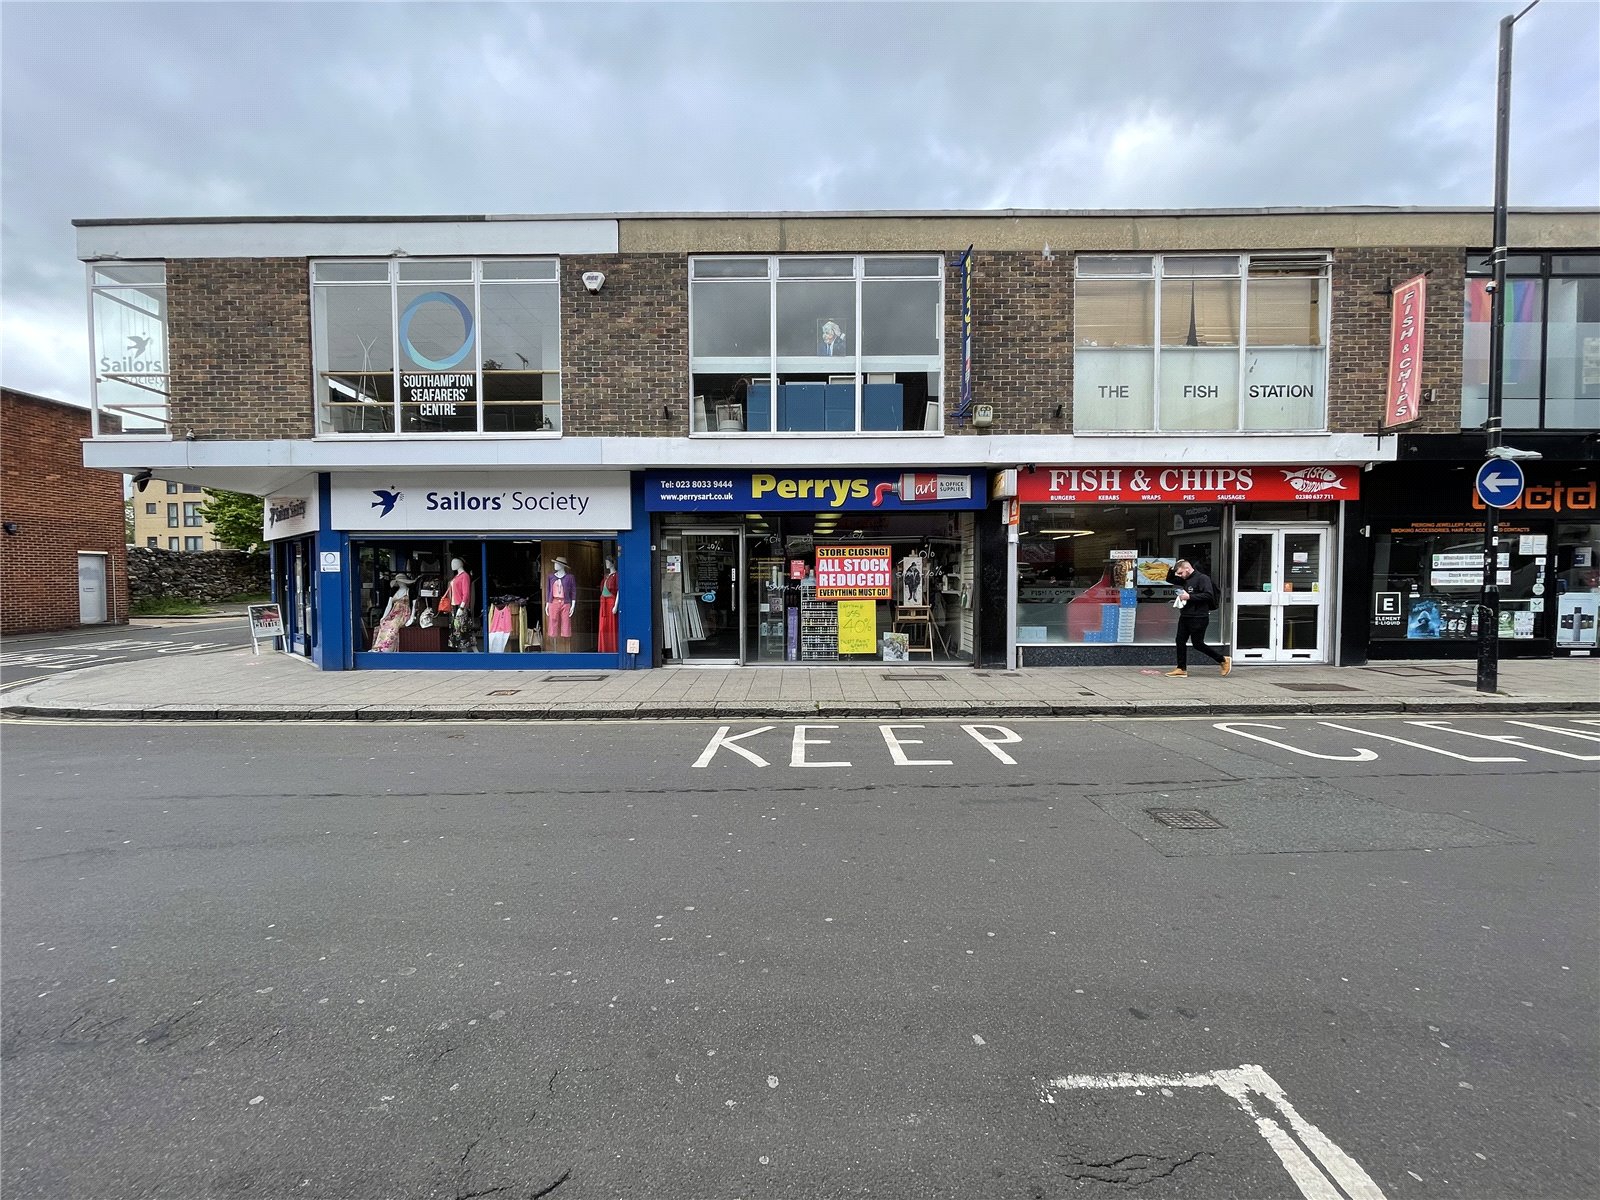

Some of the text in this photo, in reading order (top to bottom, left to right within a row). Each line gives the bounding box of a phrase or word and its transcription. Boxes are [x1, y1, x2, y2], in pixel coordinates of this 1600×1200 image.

[1395, 290, 1414, 417] FISH & CHIPS
[403, 374, 473, 388] SOUTHAMPTON
[1098, 384, 1314, 398] THE FISH STATION
[420, 403, 457, 416] CENTRE
[1048, 468, 1254, 492] FISH & CHIPS
[1303, 467, 1328, 479] FISH
[660, 480, 733, 489] Tel: 023 8033 9444
[751, 474, 869, 507] Perrys
[915, 478, 938, 496] art
[512, 491, 590, 516] Society
[660, 492, 734, 502] www.perrysart.co.uk
[819, 548, 889, 557] STORE CLOSING!
[818, 559, 841, 572] ALL
[843, 558, 889, 572] STOCK
[819, 573, 890, 587] REDUCED!
[819, 588, 889, 597] EVERYTHING MUST GO!
[1383, 597, 1394, 611] E
[842, 617, 872, 634] 40%
[691, 724, 1023, 768] KEEP
